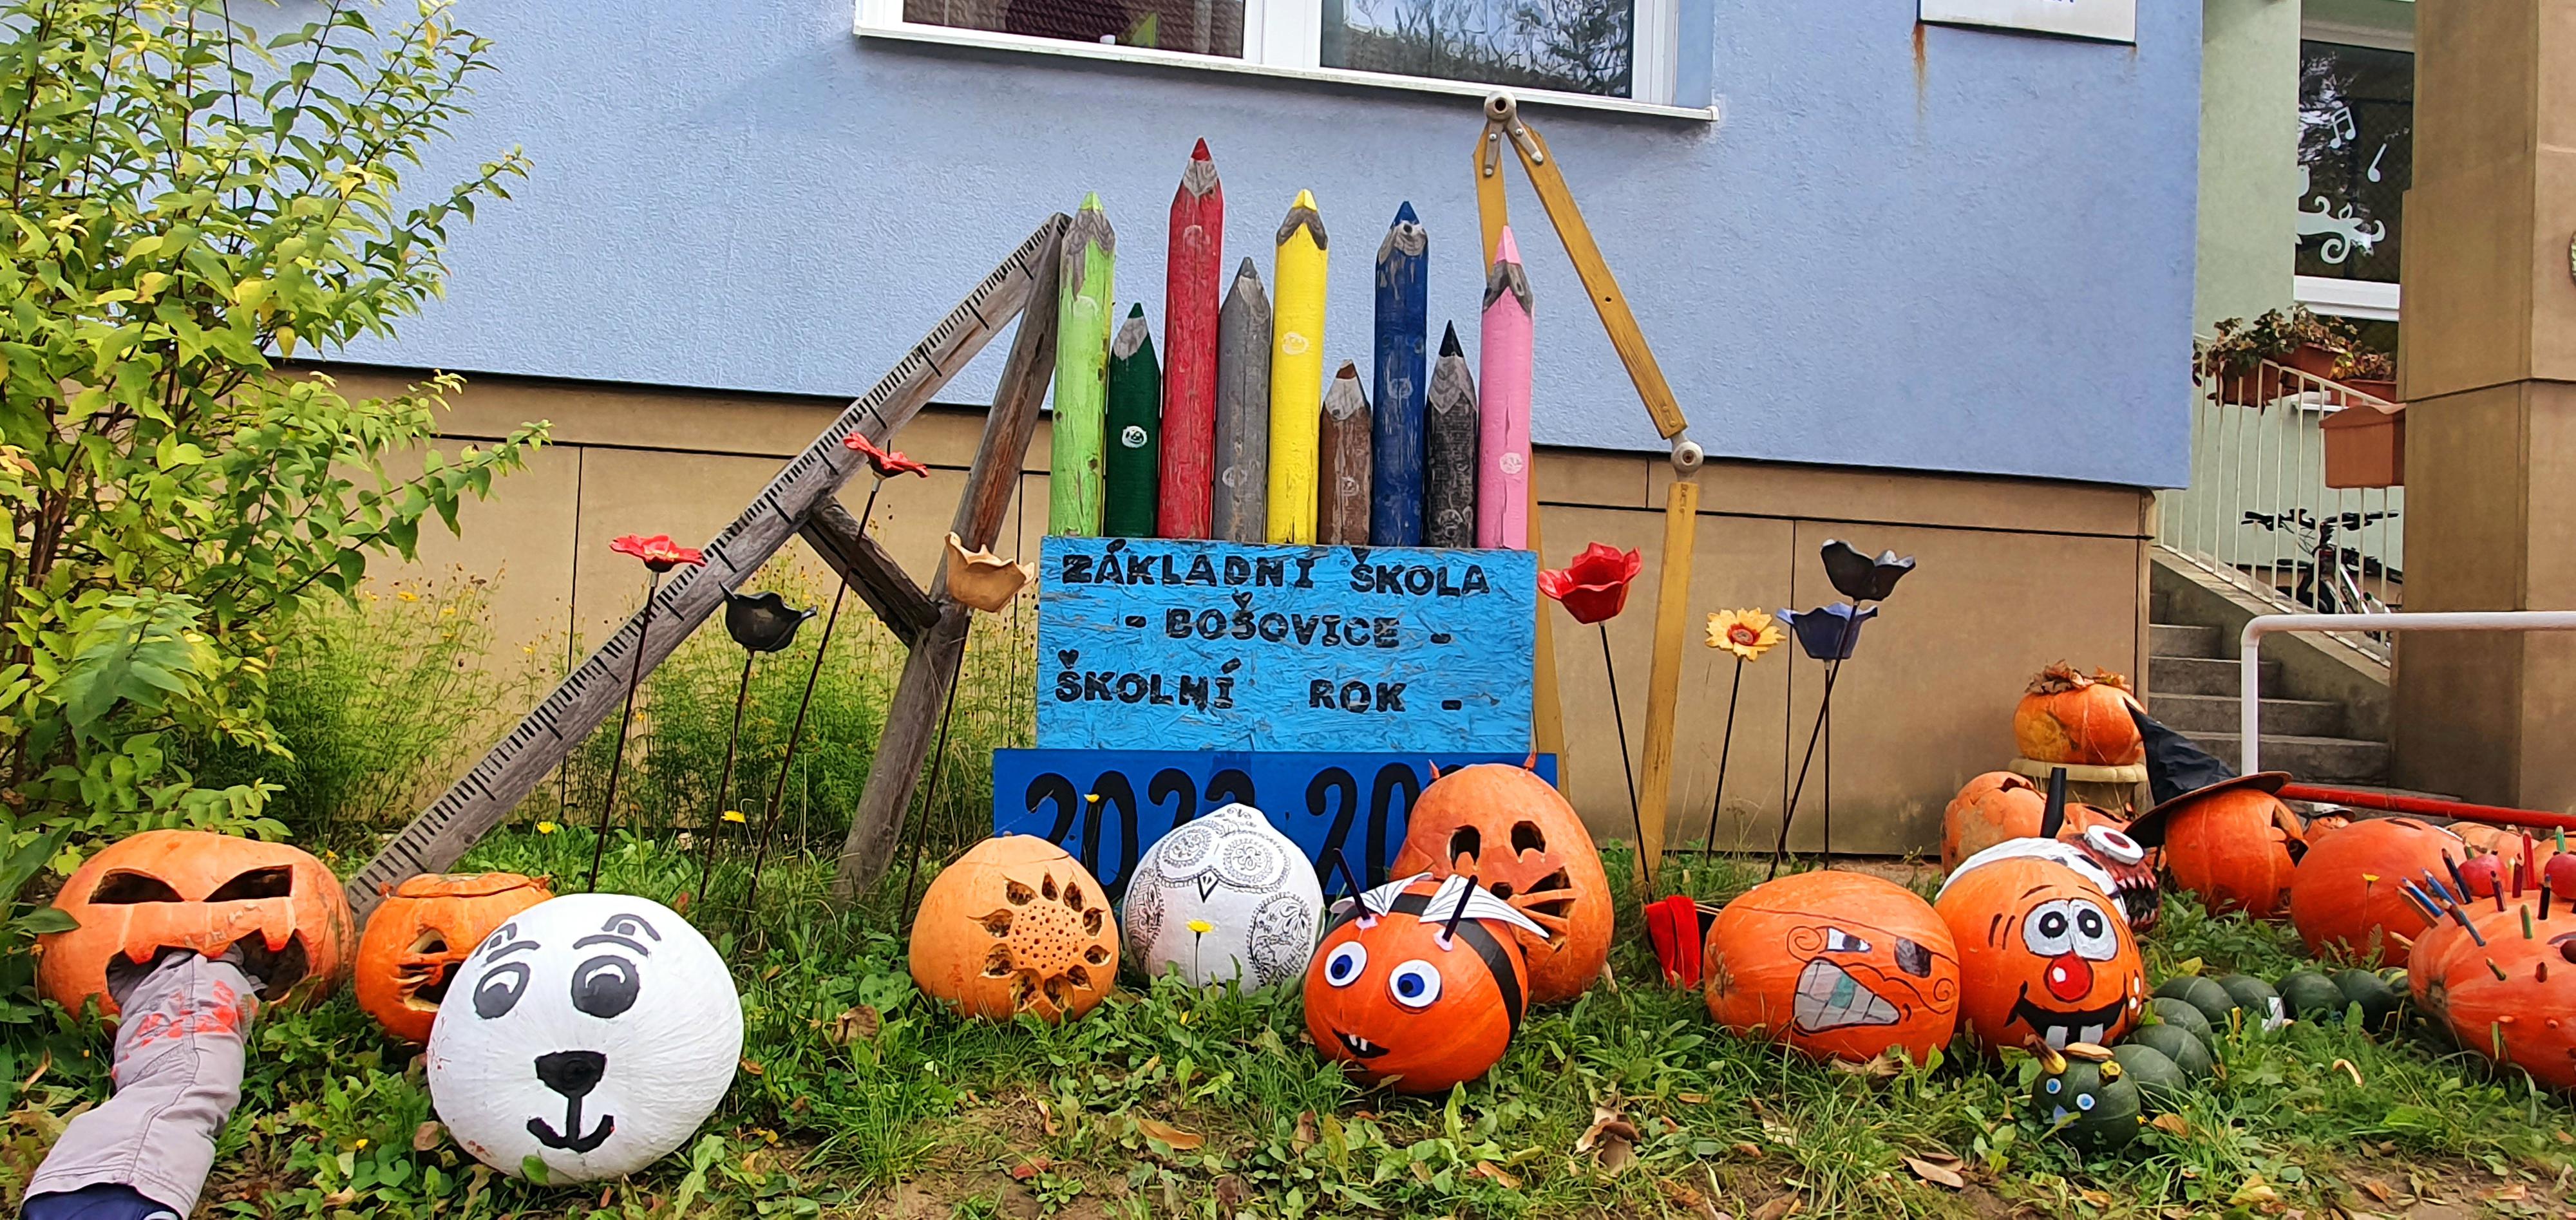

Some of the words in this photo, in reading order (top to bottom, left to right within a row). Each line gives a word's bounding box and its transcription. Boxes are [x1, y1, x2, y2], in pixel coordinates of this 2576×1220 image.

[1350, 547, 1490, 596] ŠKOLA
[1166, 591, 1400, 647] BOŠOVICE
[1055, 649, 1242, 715] ŠKOLNÍ
[1309, 679, 1406, 713] ROK
